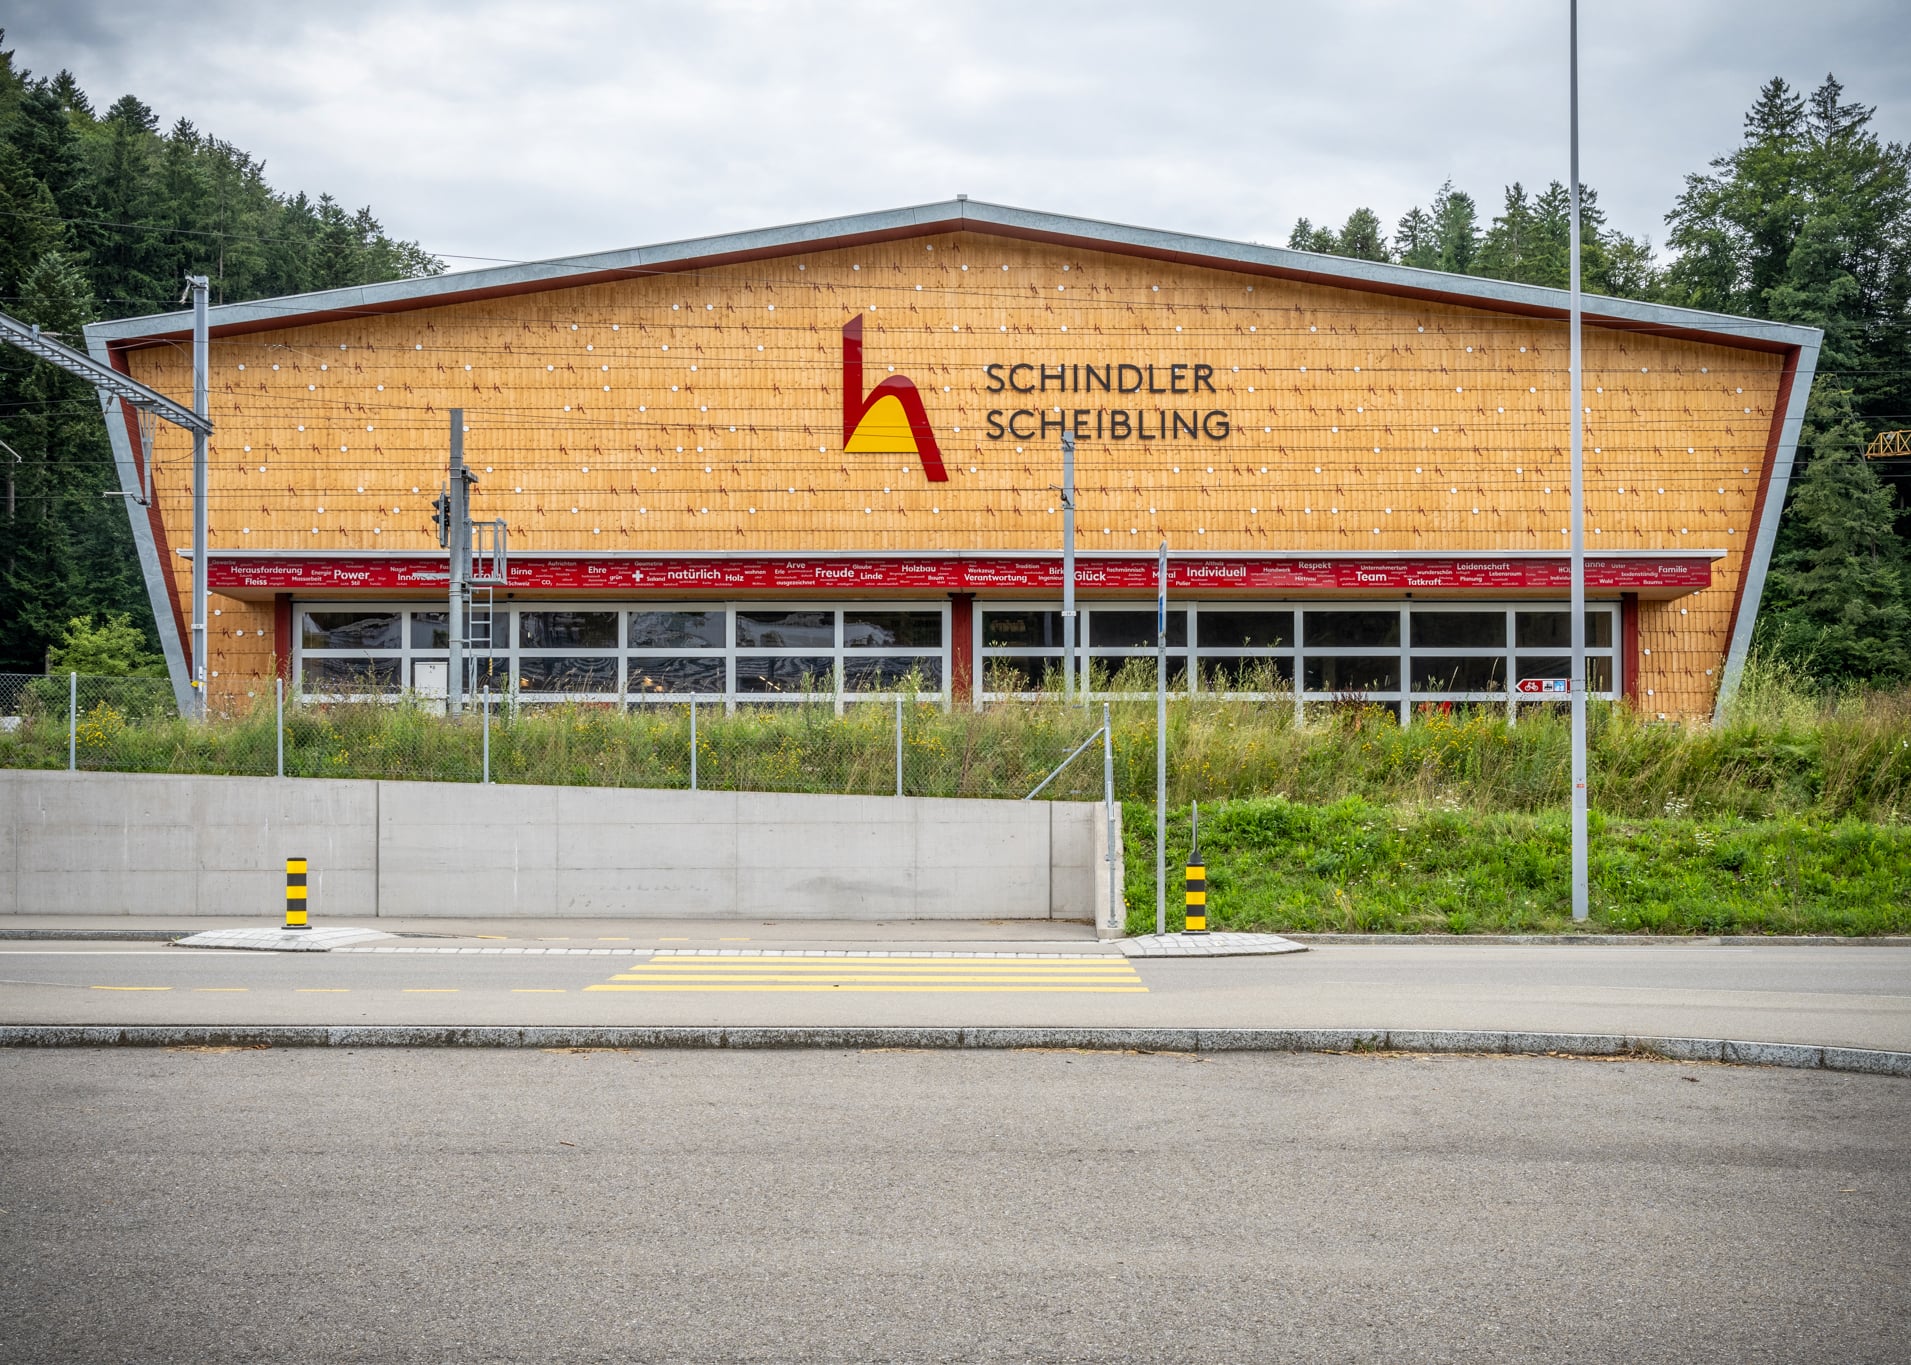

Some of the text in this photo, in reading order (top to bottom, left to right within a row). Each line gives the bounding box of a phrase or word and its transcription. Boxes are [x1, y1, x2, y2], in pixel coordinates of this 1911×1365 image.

[985, 362, 1217, 395] SCHINDLER
[985, 409, 1231, 441] SCHEIBLING
[786, 561, 806, 569] Arve
[901, 564, 936, 573] Holzbau
[1298, 561, 1332, 570] Respekt
[1456, 562, 1510, 571] Leidenschaft
[1658, 565, 1688, 573] Familie
[231, 566, 303, 576] Herausforderung
[334, 569, 370, 580] Power
[511, 567, 533, 575] Birne
[588, 566, 607, 574] Ehre
[668, 569, 721, 580] natürlich
[815, 567, 855, 578] Freude
[1049, 567, 1065, 575] Birk
[1187, 567, 1246, 577] Individuell
[398, 573, 443, 581] Innov
[725, 574, 744, 582] Holz
[860, 572, 883, 580] Linde
[964, 574, 1027, 583] Verantwortung
[1074, 571, 1106, 581] Glück
[1152, 571, 1176, 579] Mral
[1355, 571, 1387, 582] Team
[245, 578, 268, 586] Fleiss
[1407, 578, 1442, 586] Tatkraft
